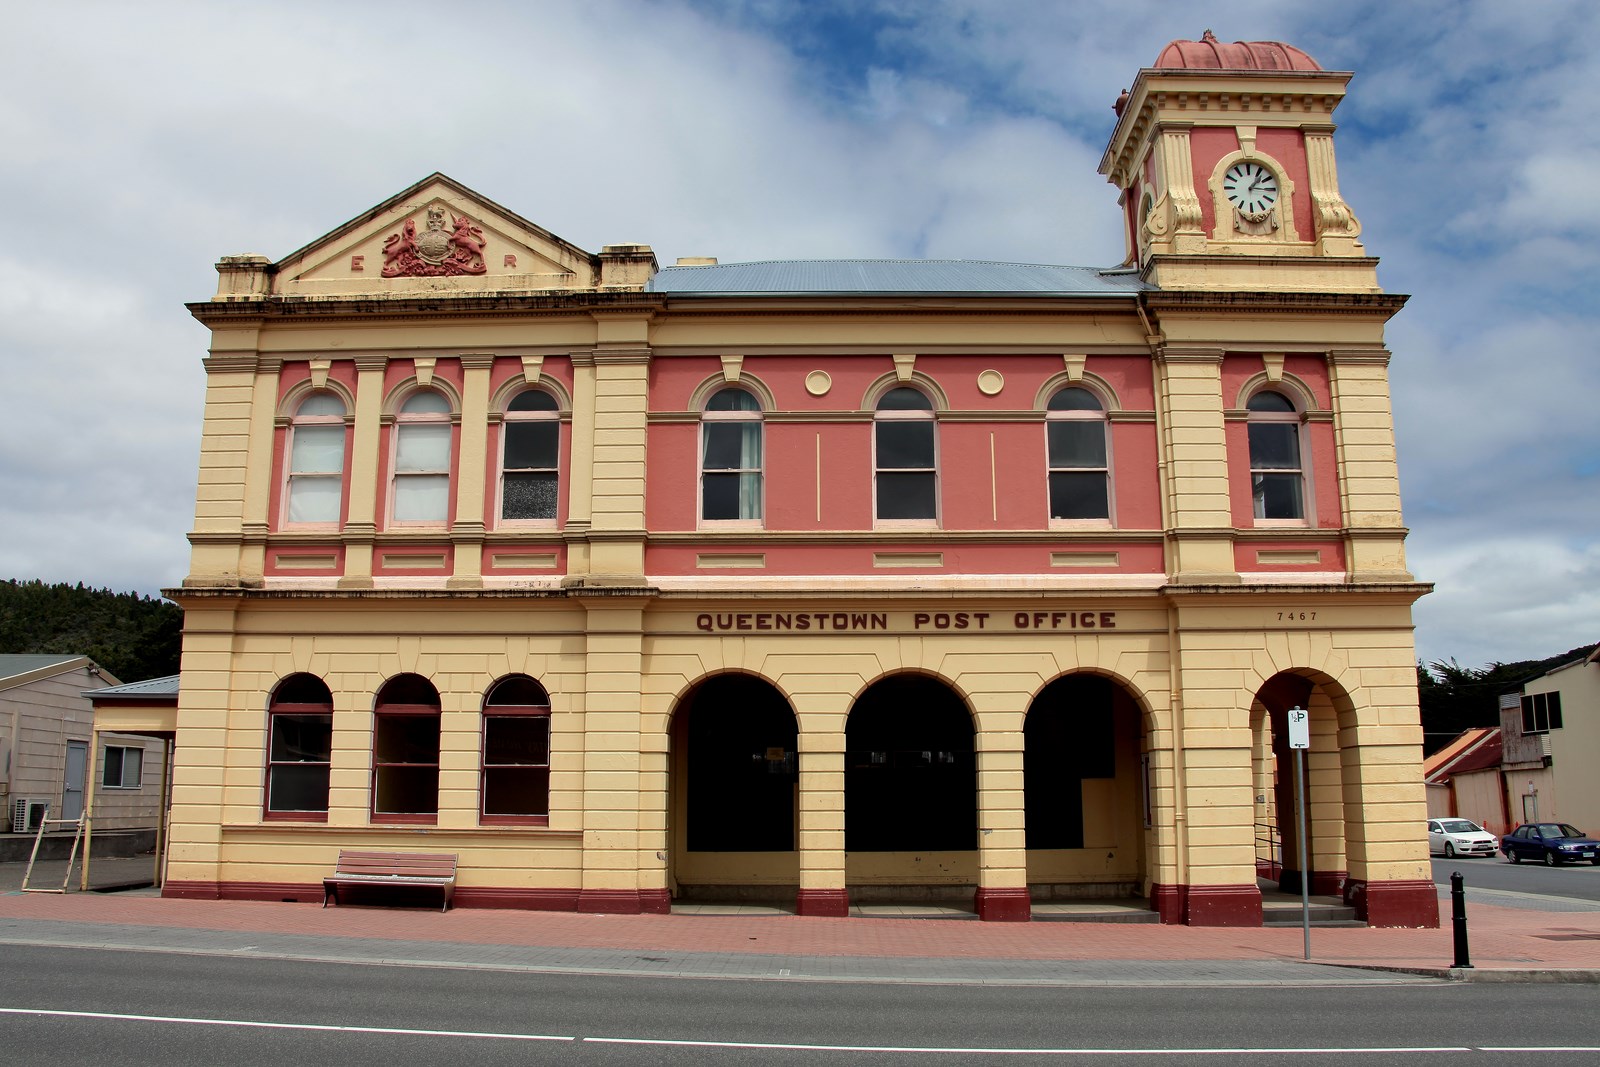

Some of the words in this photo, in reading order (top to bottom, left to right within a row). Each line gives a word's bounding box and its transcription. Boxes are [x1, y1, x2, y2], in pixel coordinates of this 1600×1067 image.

[351, 255, 365, 271] E
[503, 254, 517, 268] R
[696, 613, 887, 632] QUEENSTOWN
[914, 612, 990, 630] POST
[1014, 612, 1116, 629] OFFICE
[1276, 611, 1317, 621] 7467
